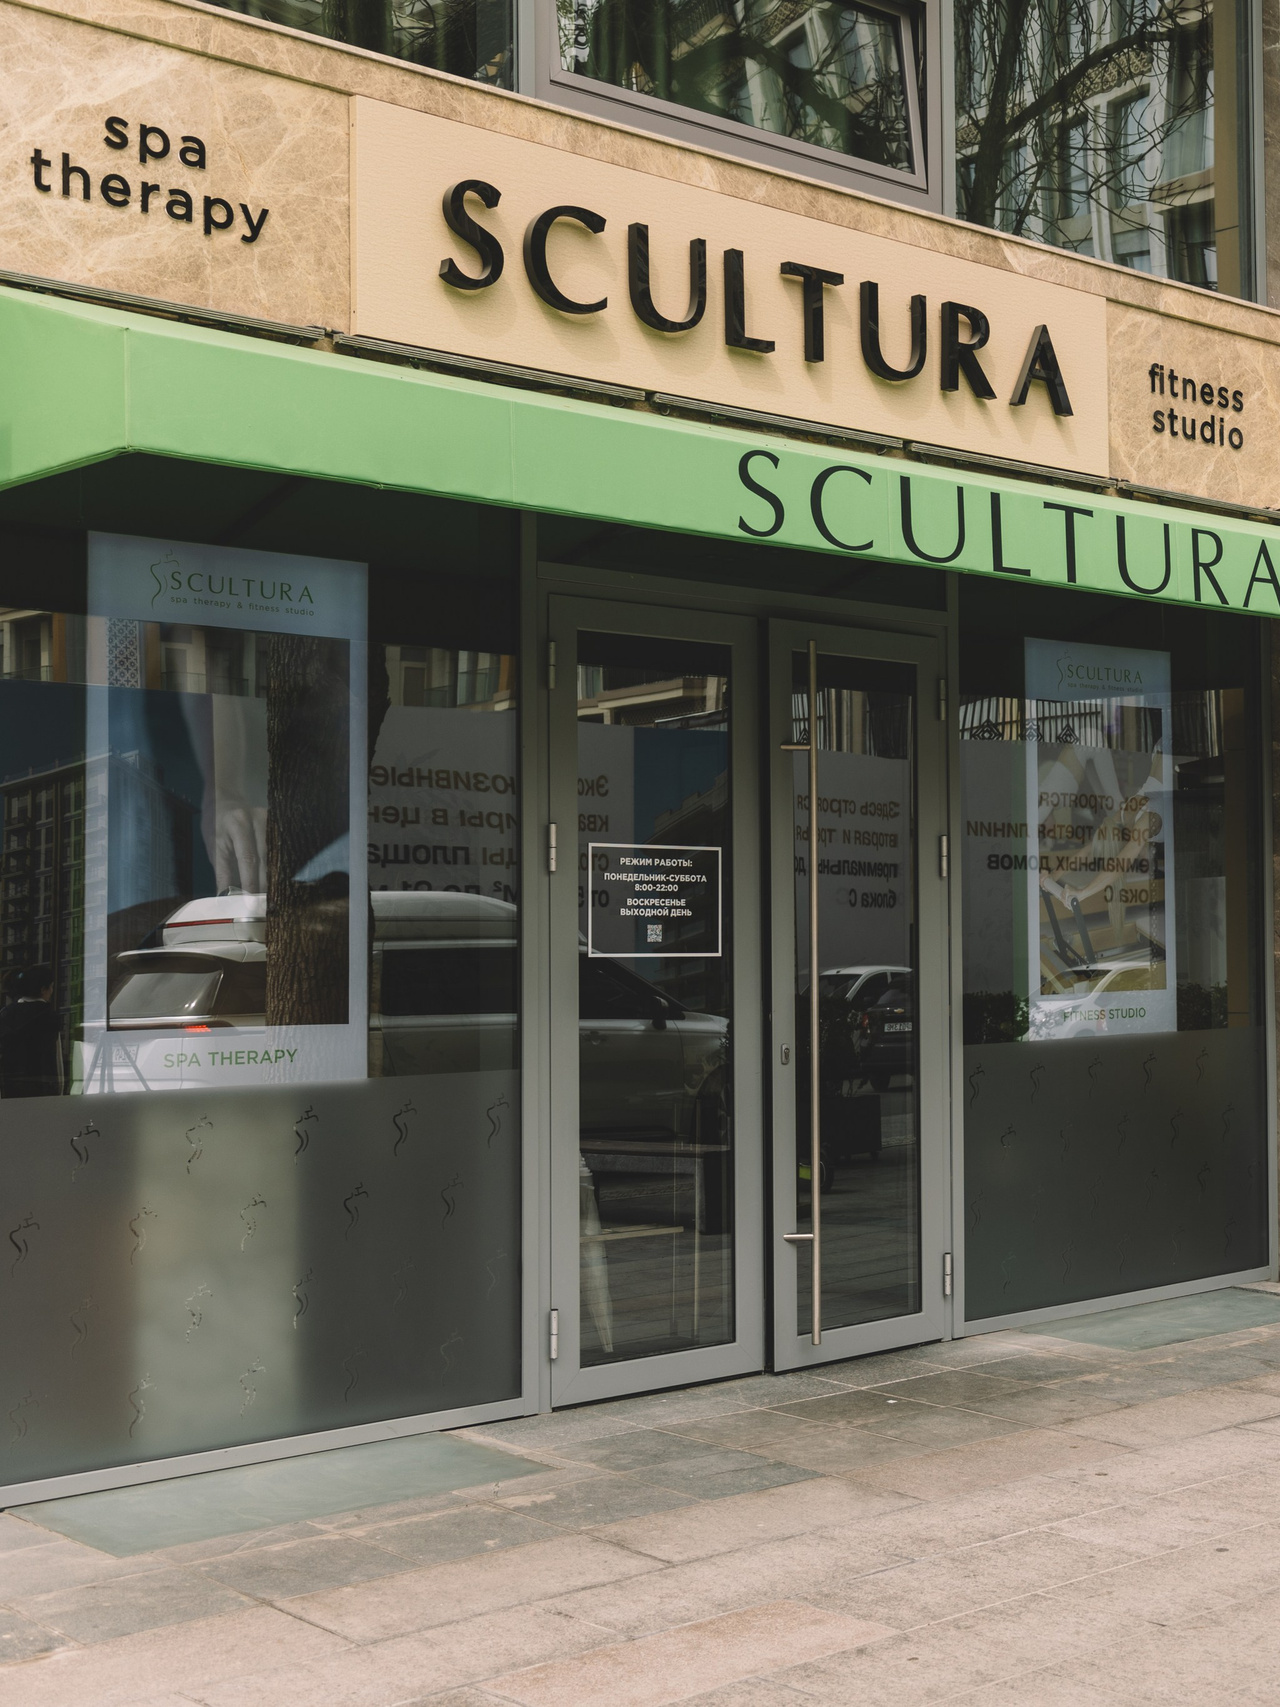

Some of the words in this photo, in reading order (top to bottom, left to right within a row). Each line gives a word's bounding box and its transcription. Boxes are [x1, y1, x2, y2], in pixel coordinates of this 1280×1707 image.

[104, 116, 206, 170] spa
[31, 148, 269, 243] therapy
[439, 179, 1074, 417] SCULTURA
[1149, 362, 1244, 412] fitness
[1153, 408, 1244, 450] studio
[170, 571, 314, 604] SCULTURA
[170, 596, 188, 605] spa
[193, 597, 231, 609] therapy
[248, 602, 280, 613] fitness
[285, 606, 315, 616] studio
[1067, 664, 1143, 684] SCULTURA
[620, 857, 653, 866] РЕЖИМ
[654, 858, 693, 868] РАБОТЫ:
[604, 872, 707, 883] ПОНЕДЕЛЬНИК-СУББОТА
[634, 883, 679, 892] 8:00-22:00
[620, 906, 669, 917] ВЫХОДНОЙ
[670, 908, 693, 917] ДЕНЬ
[626, 898, 687, 907] ВОСКРЕСЕНЬЕ
[1063, 1009, 1106, 1022] FITNESS
[1108, 1007, 1146, 1020] STUDIO
[163, 1052, 201, 1068] SPA
[207, 1048, 298, 1066] THERAPY
